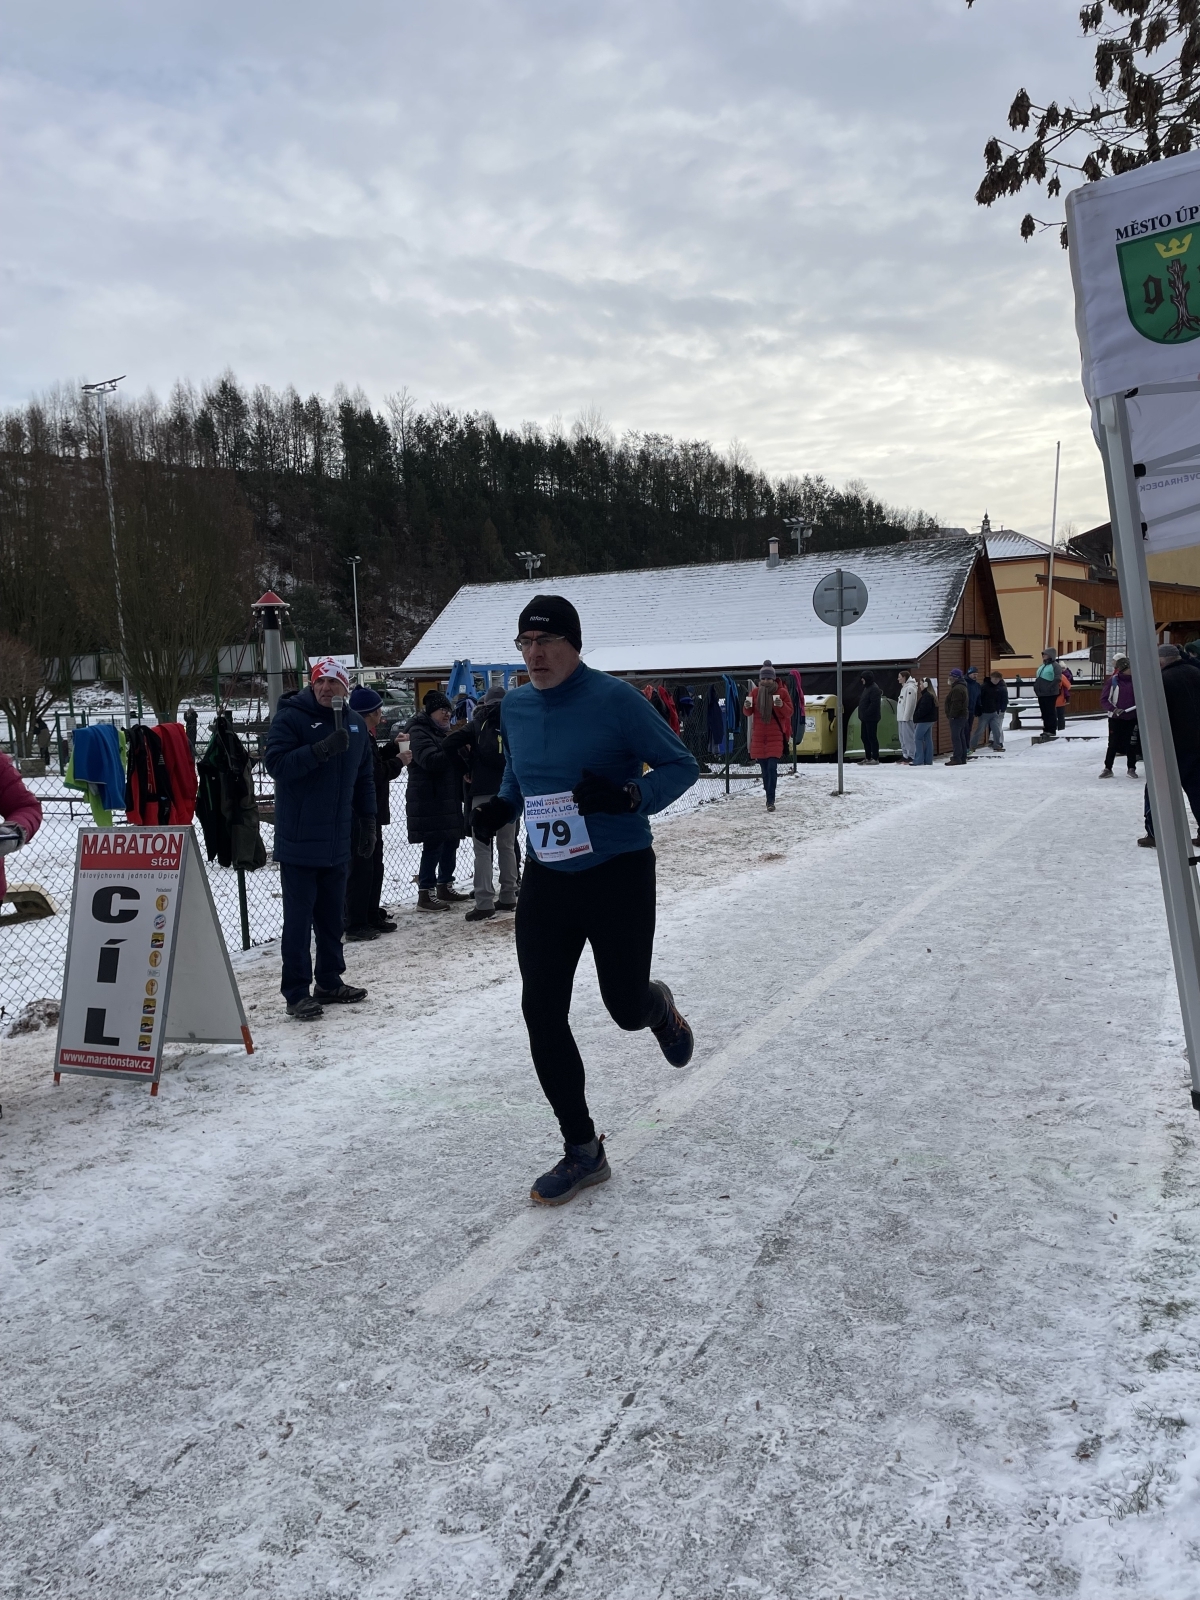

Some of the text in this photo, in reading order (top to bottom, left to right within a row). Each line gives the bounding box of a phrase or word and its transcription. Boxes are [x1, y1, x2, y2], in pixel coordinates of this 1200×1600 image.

[1115, 204, 1200, 241] MĚSTO ÚP
[526, 798, 544, 808] ZIMNÍ
[81, 833, 184, 855] MARATON
[536, 820, 571, 848] 79
[150, 856, 178, 867] stav
[79, 871, 179, 881] tělovýchovná jednota Úpice
[84, 886, 141, 1046] CÍL
[63, 1052, 152, 1070] www.maratonstav.cz
